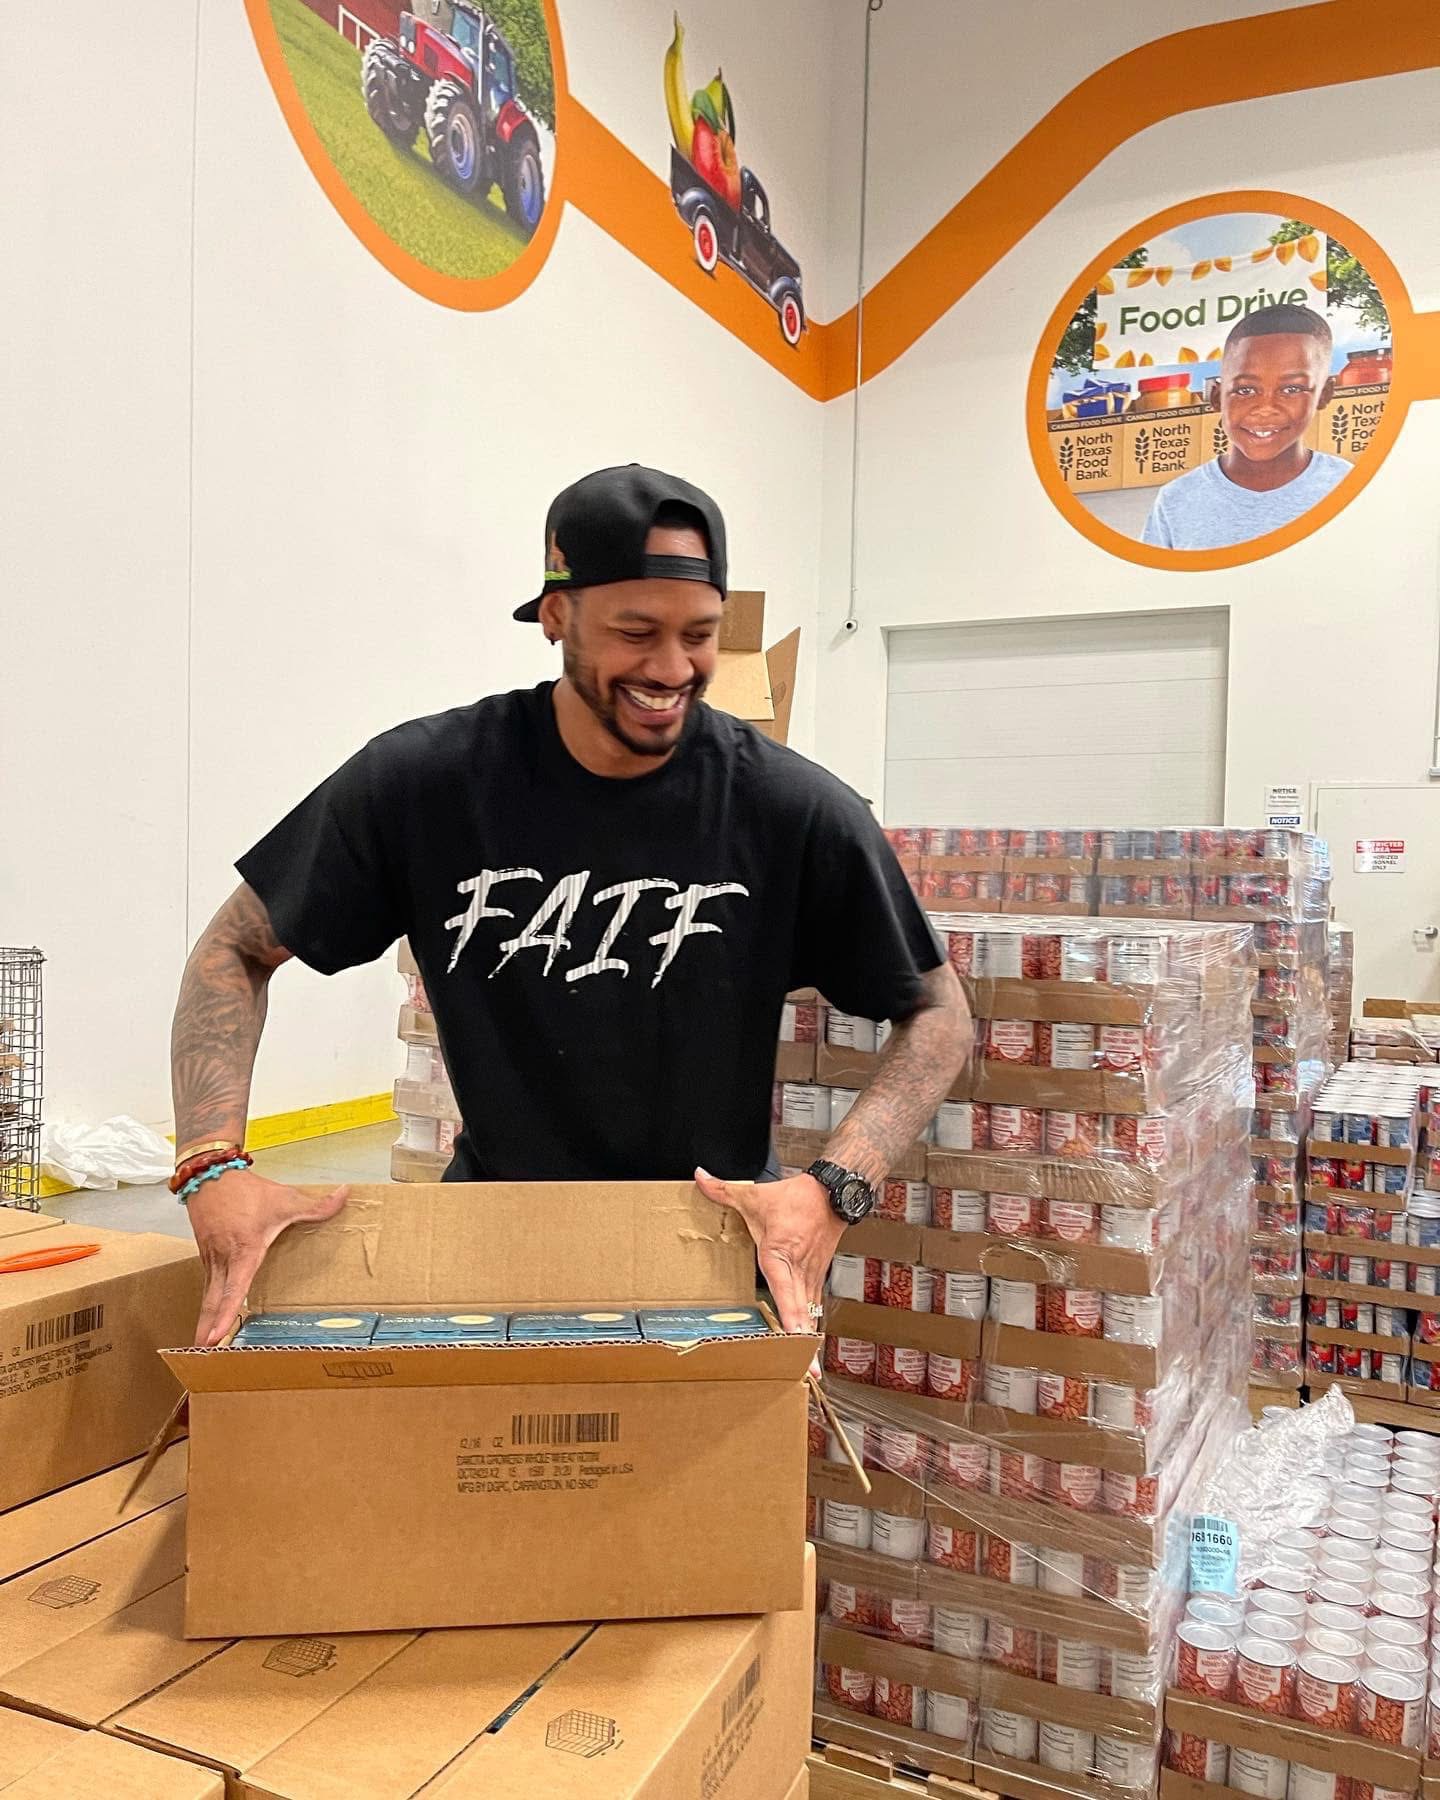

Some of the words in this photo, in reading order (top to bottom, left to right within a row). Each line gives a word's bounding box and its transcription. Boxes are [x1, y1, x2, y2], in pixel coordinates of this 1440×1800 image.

[1120, 299, 1206, 335] Food
[1217, 288, 1308, 322] Drive
[1156, 410, 1177, 418] FOOD
[1352, 400, 1385, 415] Nort
[1152, 424, 1191, 437] North
[1076, 433, 1113, 446] North
[1153, 437, 1190, 449] Texas
[1077, 446, 1112, 458] Texas
[1152, 448, 1186, 461] Food
[1076, 457, 1109, 469] Food
